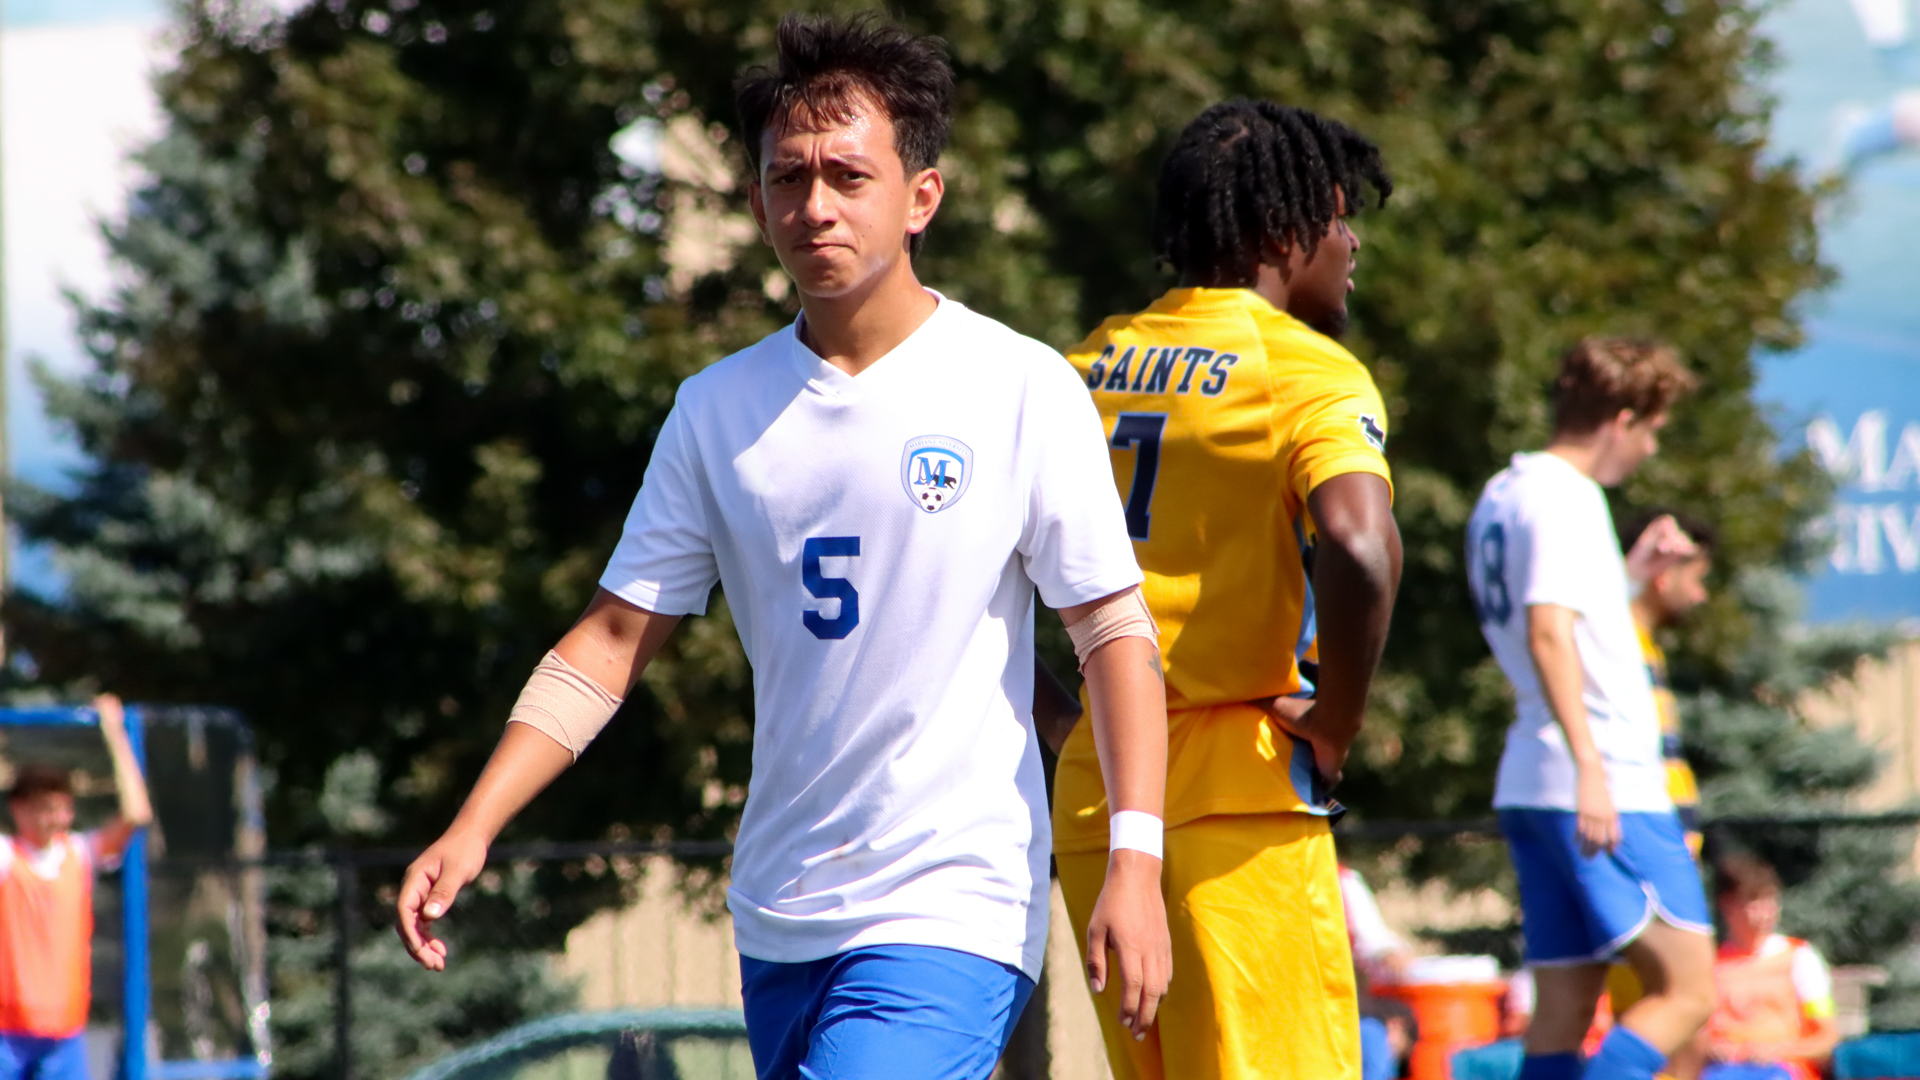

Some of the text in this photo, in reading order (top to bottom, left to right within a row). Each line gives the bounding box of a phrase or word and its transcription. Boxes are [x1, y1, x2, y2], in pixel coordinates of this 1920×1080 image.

[1087, 344, 1239, 397] SAINTS
[1110, 411, 1169, 542] 7
[802, 535, 861, 640] 5
